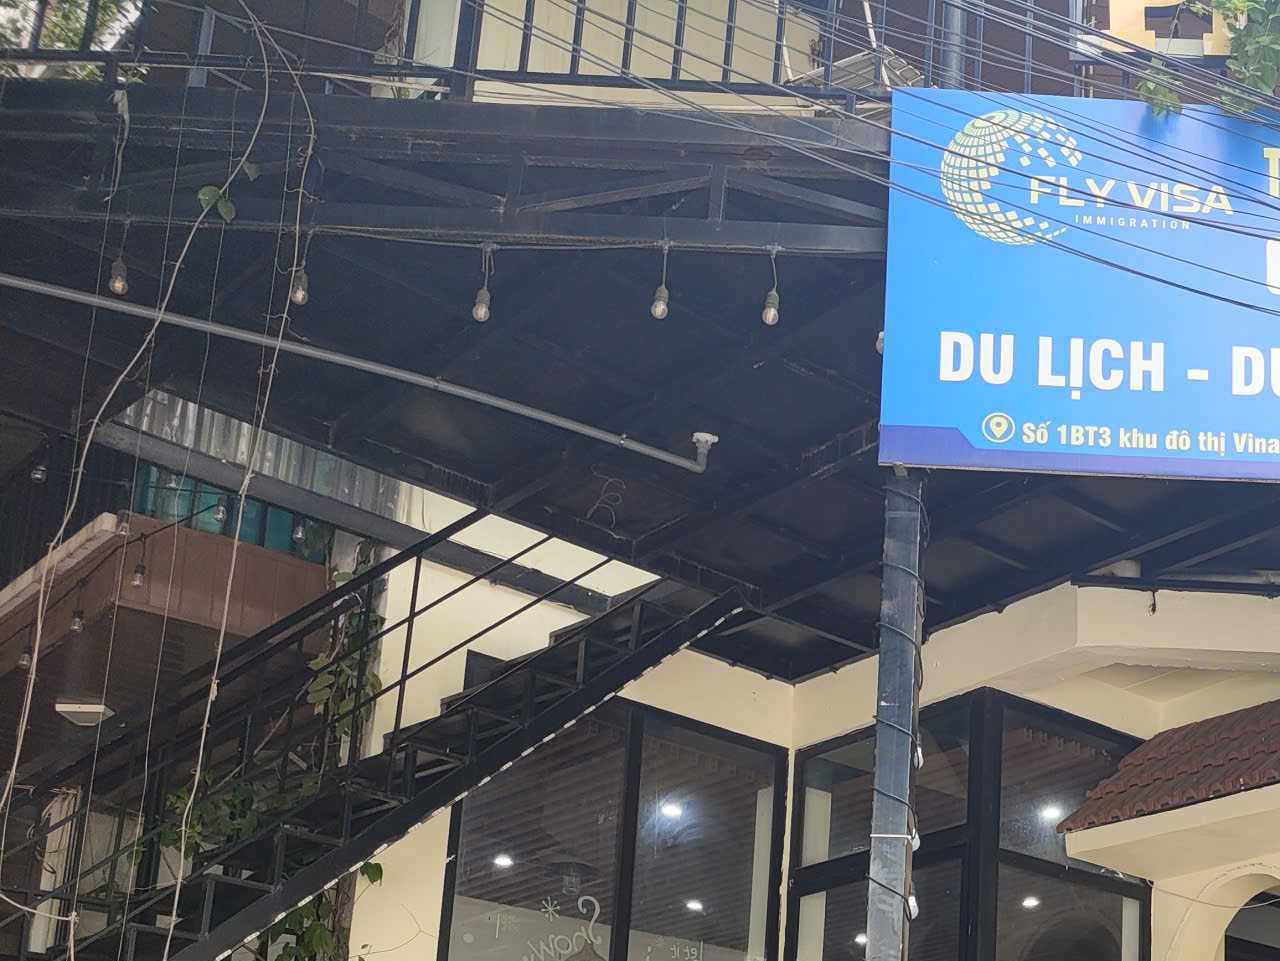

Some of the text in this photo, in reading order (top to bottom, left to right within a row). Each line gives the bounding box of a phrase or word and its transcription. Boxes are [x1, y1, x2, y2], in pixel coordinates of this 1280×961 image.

[1029, 174, 1235, 215] FLY VISA
[1074, 214, 1191, 230] IMMIGRATION
[938, 331, 1015, 385] DU
[1037, 336, 1165, 404] LỊCH
[1186, 368, 1210, 382] -
[1022, 420, 1052, 445] Số
[1056, 423, 1112, 448] 1BT3
[1118, 427, 1158, 450] khu
[1165, 429, 1191, 451] đô
[1197, 430, 1226, 457] thị
